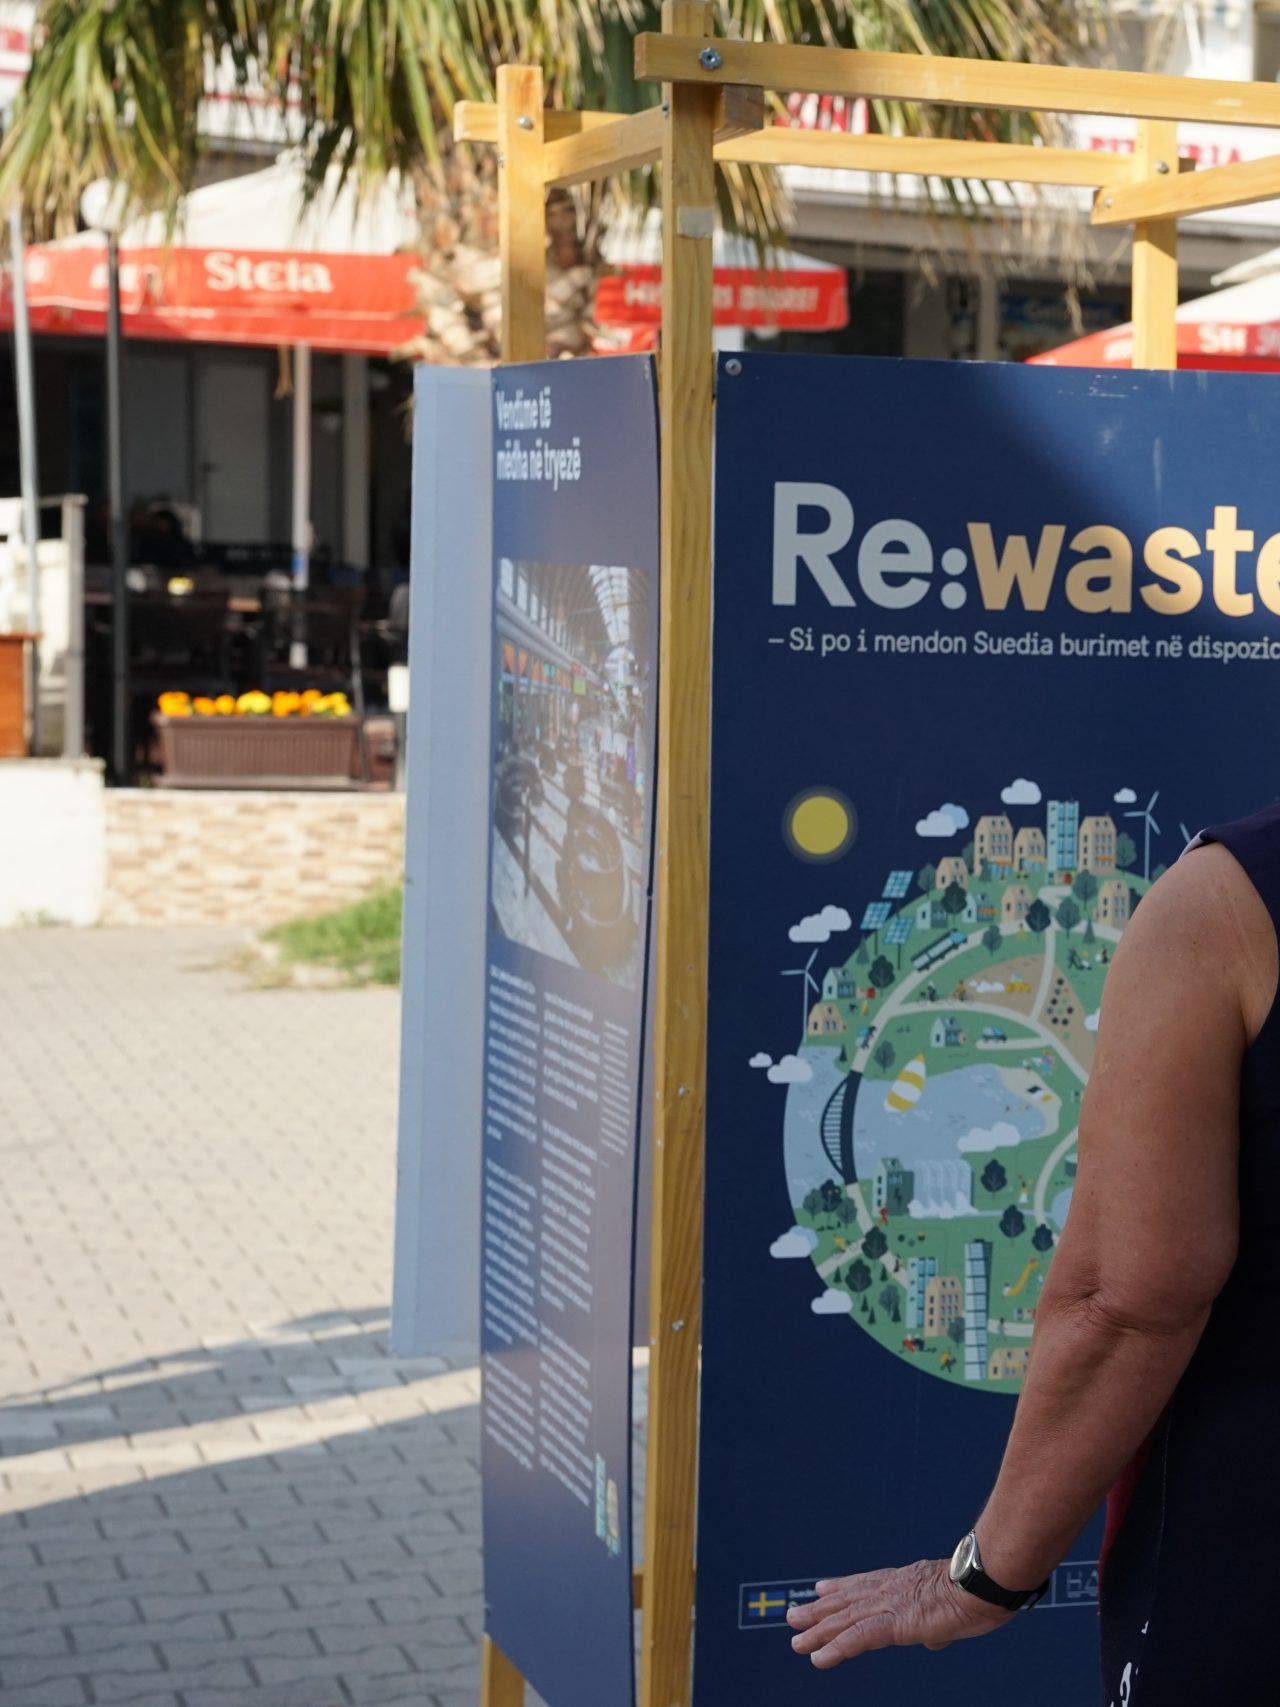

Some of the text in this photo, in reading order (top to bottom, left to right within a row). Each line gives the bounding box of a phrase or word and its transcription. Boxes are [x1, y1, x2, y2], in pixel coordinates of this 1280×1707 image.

[496, 386, 552, 430] Vendime të
[496, 436, 582, 492] mëdha në tryezë
[822, 633, 851, 657] po
[857, 629, 868, 651] i
[874, 630, 967, 653] mendon
[973, 631, 1054, 656] Suedia
[1060, 633, 1150, 657] burimet
[1156, 635, 1182, 657] në
